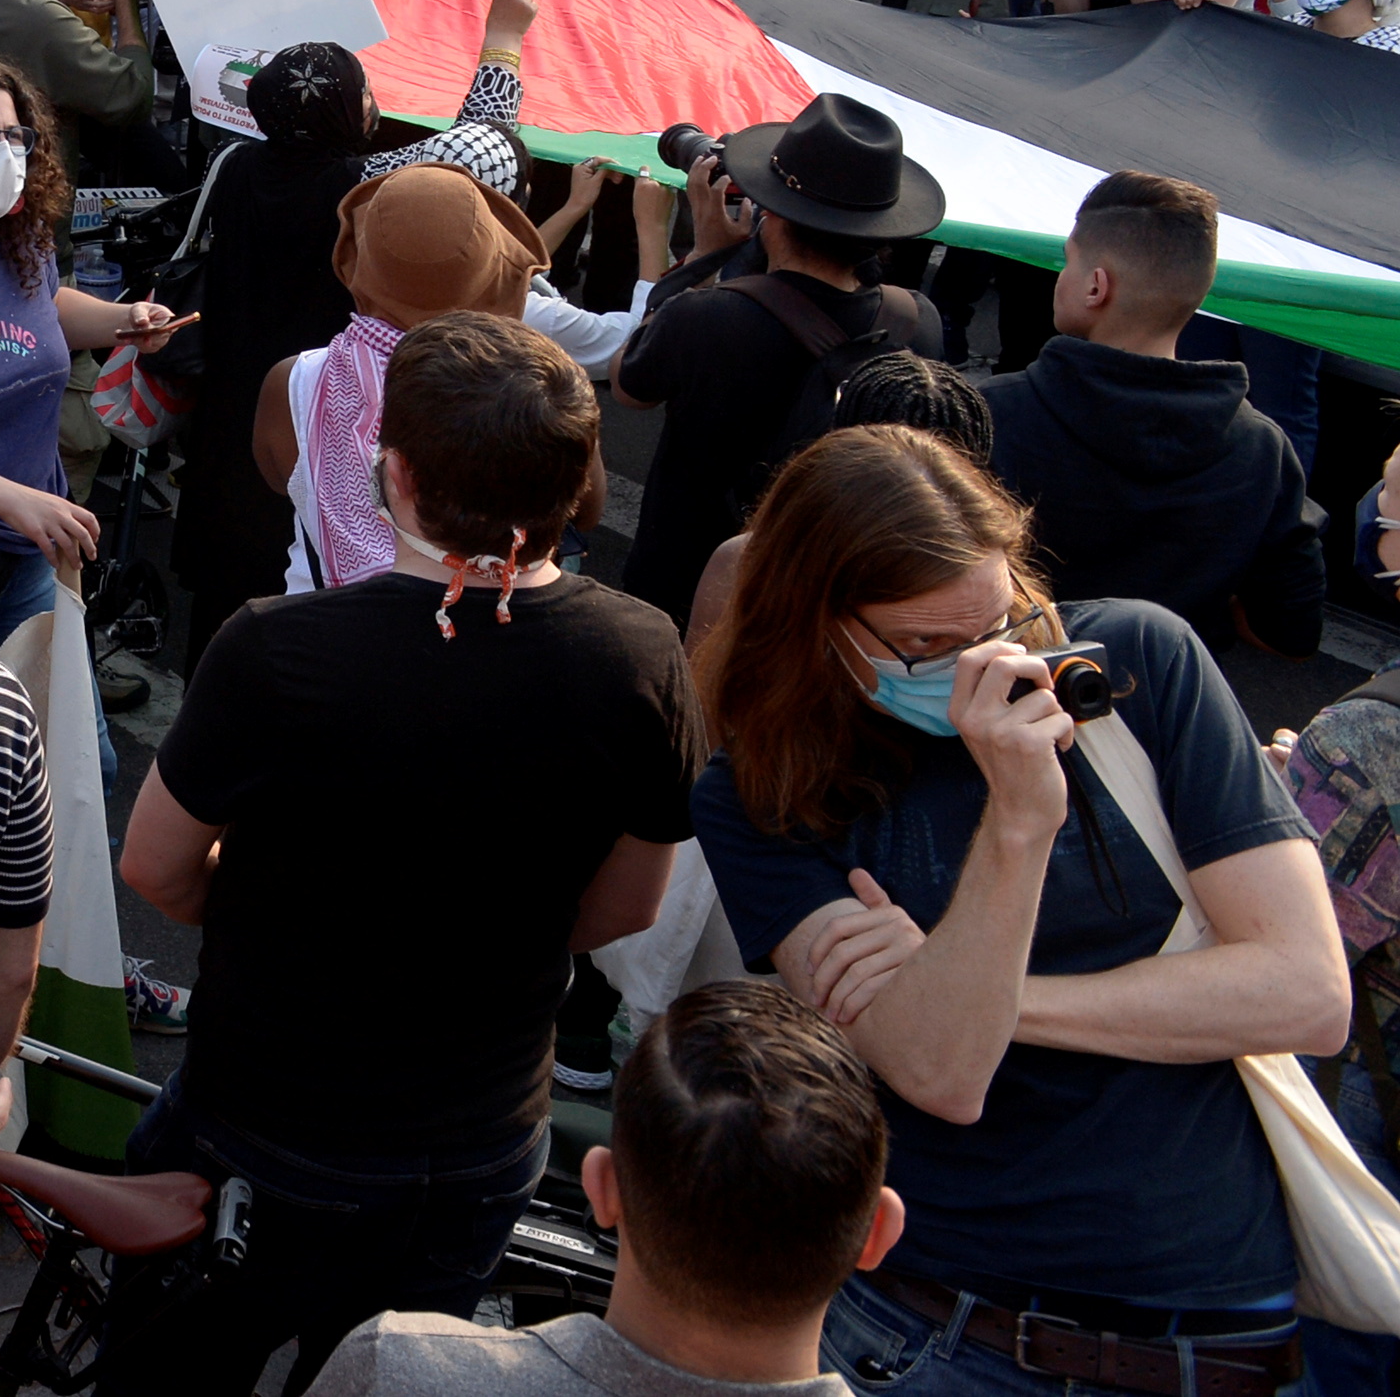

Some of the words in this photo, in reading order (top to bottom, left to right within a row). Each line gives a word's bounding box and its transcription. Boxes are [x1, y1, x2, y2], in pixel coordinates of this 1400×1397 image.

[198, 96, 236, 112] ACTIVISM:
[211, 111, 222, 121] TO
[222, 115, 256, 131] PROTEST
[526, 1228, 551, 1239] MTN
[552, 1235, 581, 1248] RACK
